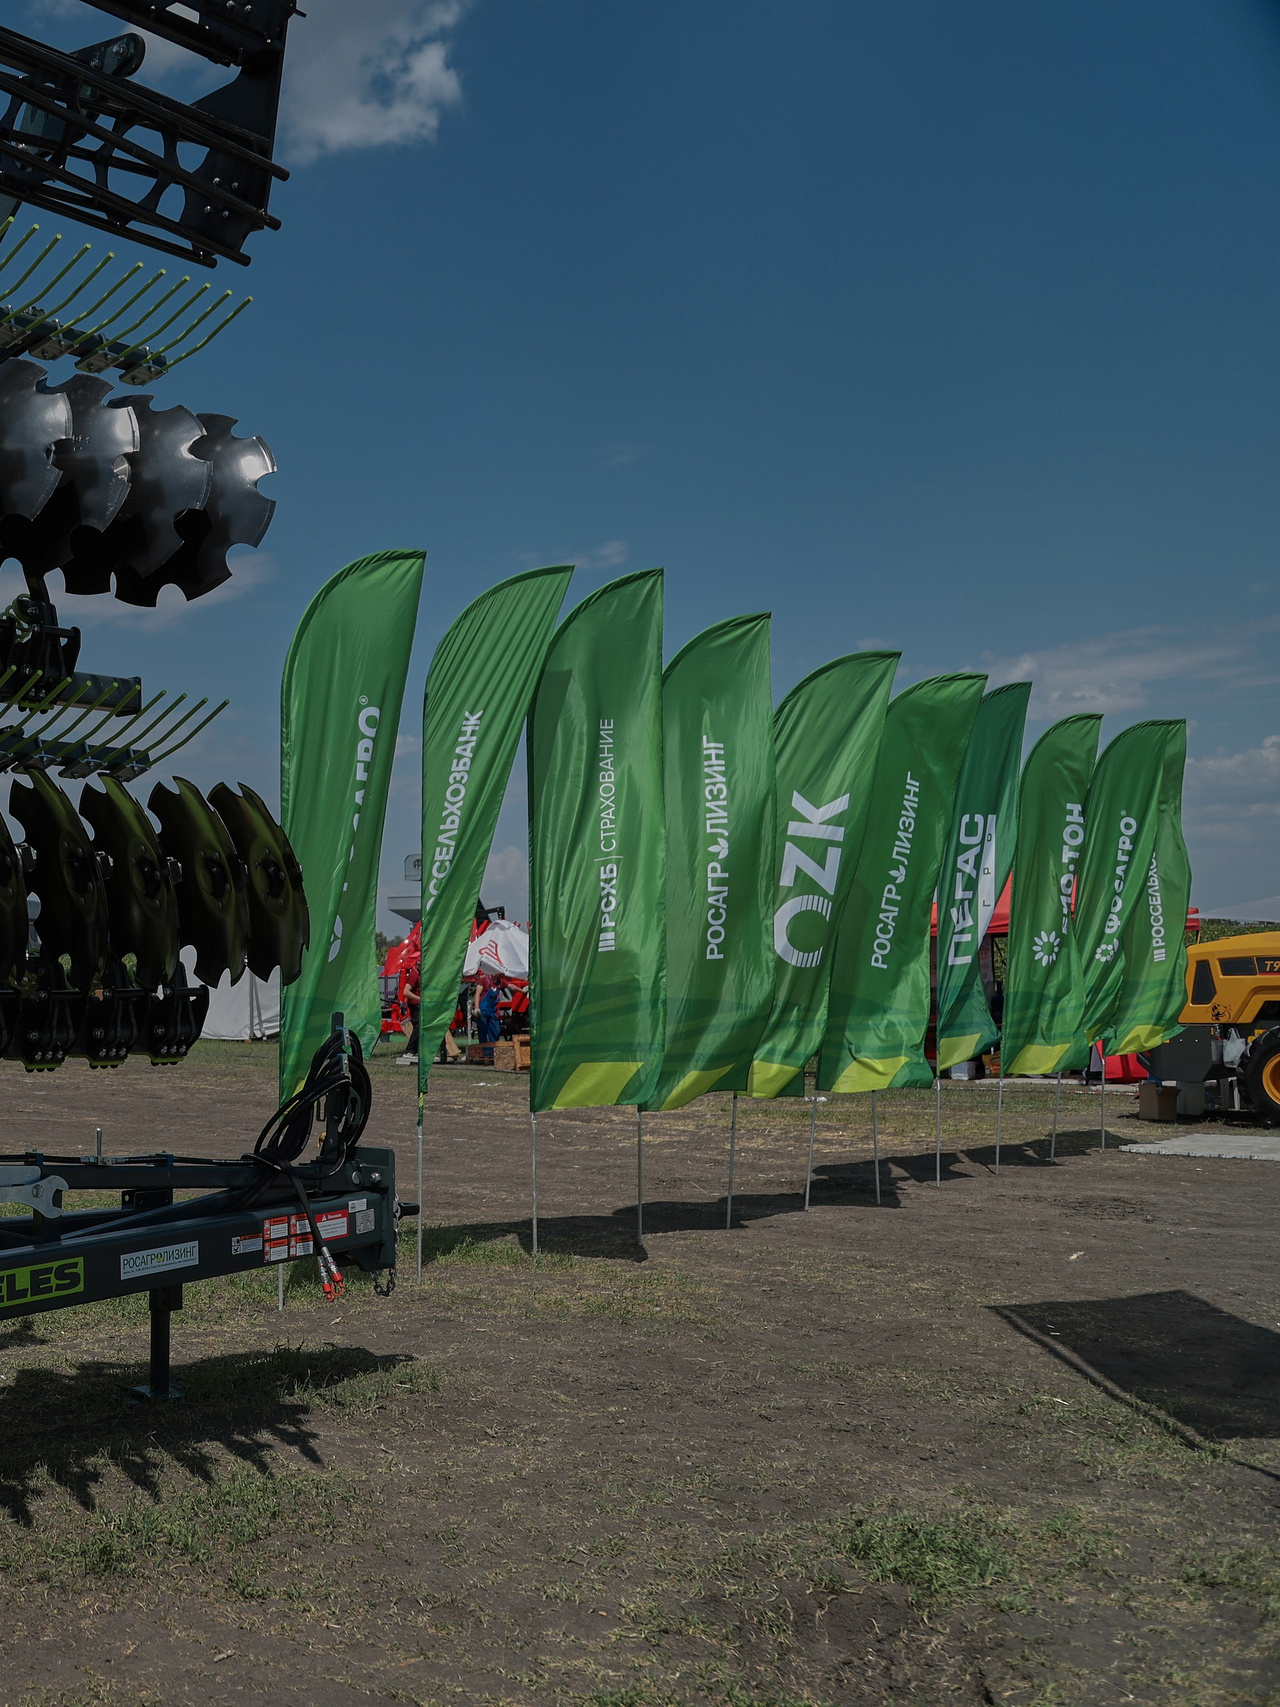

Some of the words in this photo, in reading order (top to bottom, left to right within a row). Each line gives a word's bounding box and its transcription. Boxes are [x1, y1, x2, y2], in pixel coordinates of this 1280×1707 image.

[426, 709, 484, 911] ССЕЛЬХОЗБАНК
[599, 718, 617, 852] СТРАХОВАНИЕ
[600, 863, 618, 929] РСХБ
[948, 813, 985, 966] ПЕГАС
